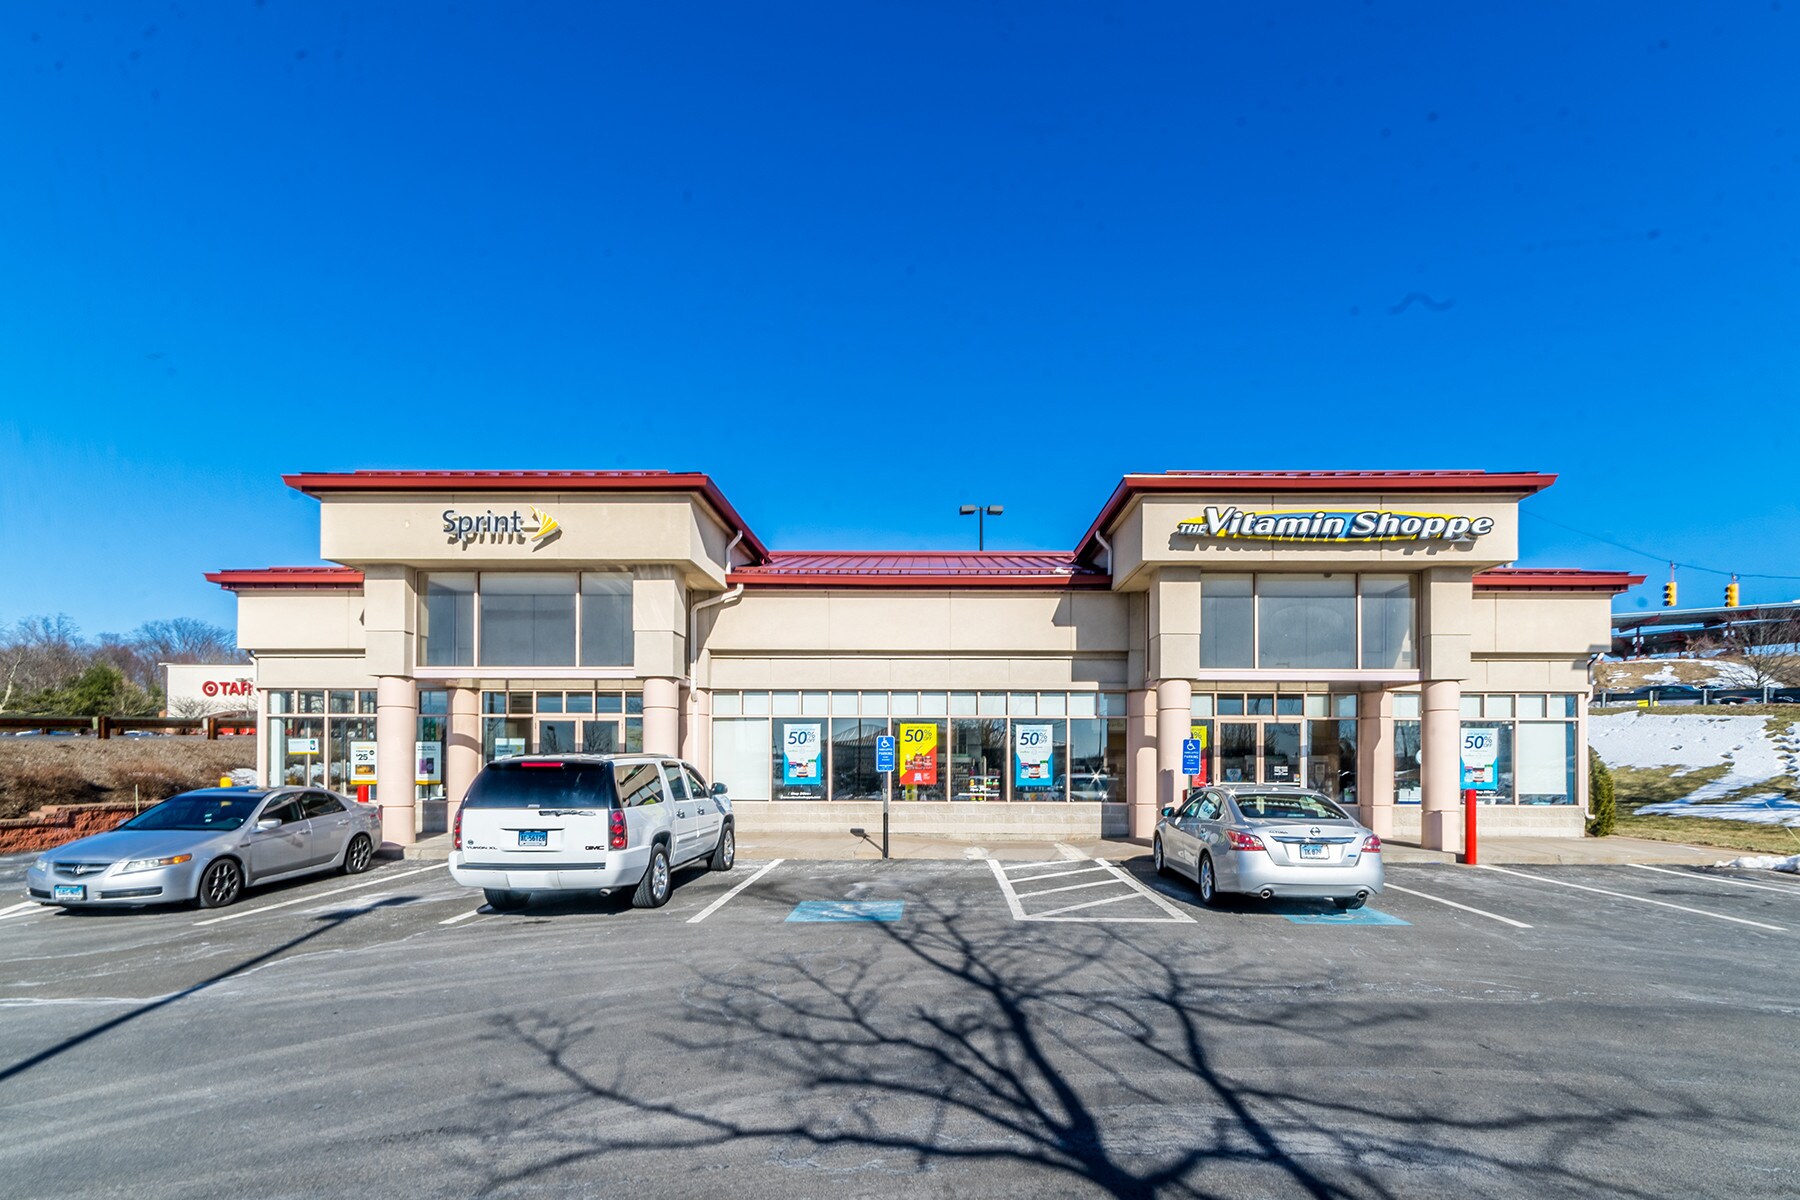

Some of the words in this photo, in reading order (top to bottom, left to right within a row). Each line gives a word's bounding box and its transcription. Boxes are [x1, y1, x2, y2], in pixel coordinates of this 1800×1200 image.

[442, 509, 521, 540] Sprint
[1178, 523, 1207, 535] THE
[1203, 506, 1346, 537] Vitamin
[1350, 511, 1494, 540] Shoppe
